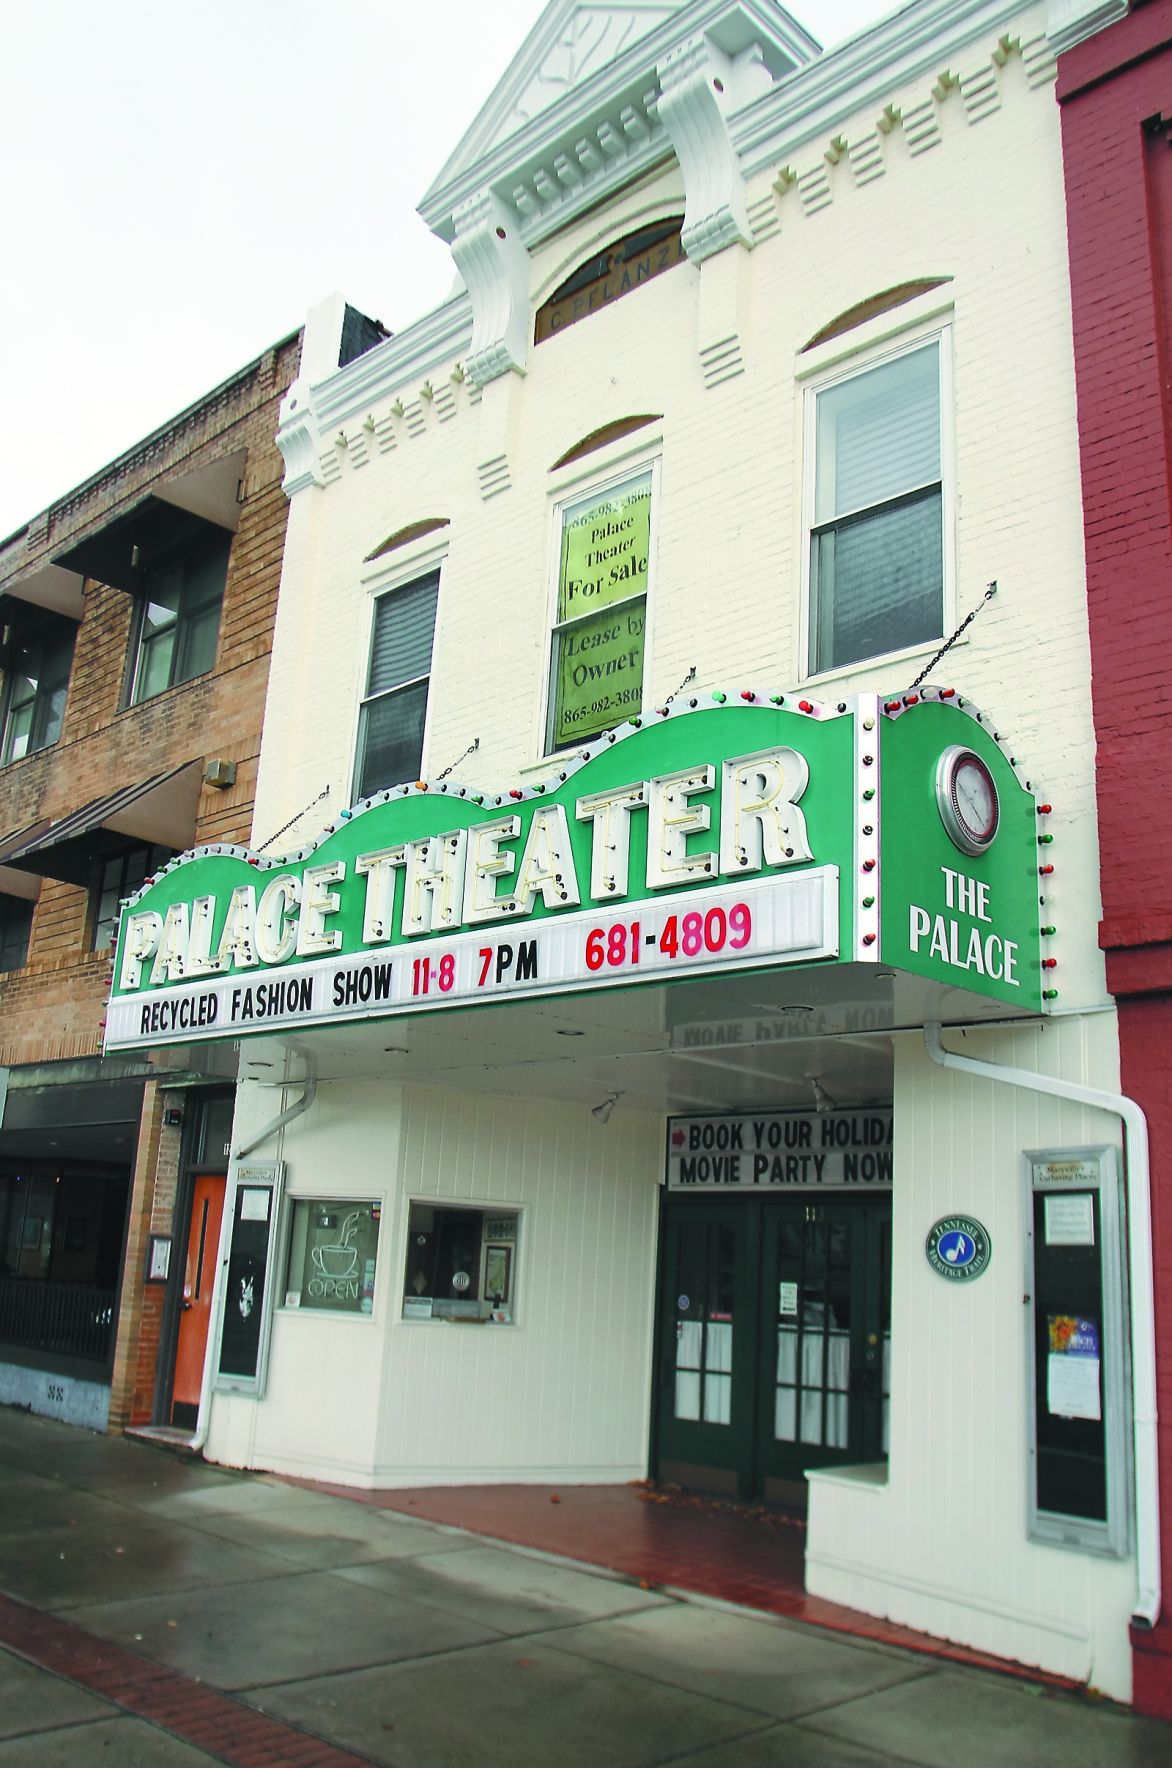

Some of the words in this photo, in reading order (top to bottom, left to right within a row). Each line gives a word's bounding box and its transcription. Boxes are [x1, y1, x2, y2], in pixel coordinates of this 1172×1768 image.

[591, 517, 634, 544] Palace
[585, 536, 636, 568] Theater
[568, 577, 604, 601] For
[608, 555, 648, 587] Sale
[566, 625, 620, 657] Lease
[627, 616, 646, 636] by
[572, 649, 639, 687] Owner
[119, 861, 347, 991] PALACE
[355, 745, 816, 945] THEATER
[940, 865, 993, 923] THE
[908, 904, 1020, 987] PALACE
[140, 993, 219, 1035] RECYCLED
[230, 977, 314, 1022] FASHION
[333, 962, 393, 1007] SHOW
[412, 953, 456, 996] 11-8
[585, 902, 752, 971] 681-4809
[688, 1123, 744, 1151] BOOK
[753, 1120, 813, 1149] YOUR
[679, 1156, 741, 1183] MOVIE
[753, 1154, 826, 1183] PARTY
[843, 1152, 894, 1182] NOW
[308, 1279, 359, 1300] OPEN
